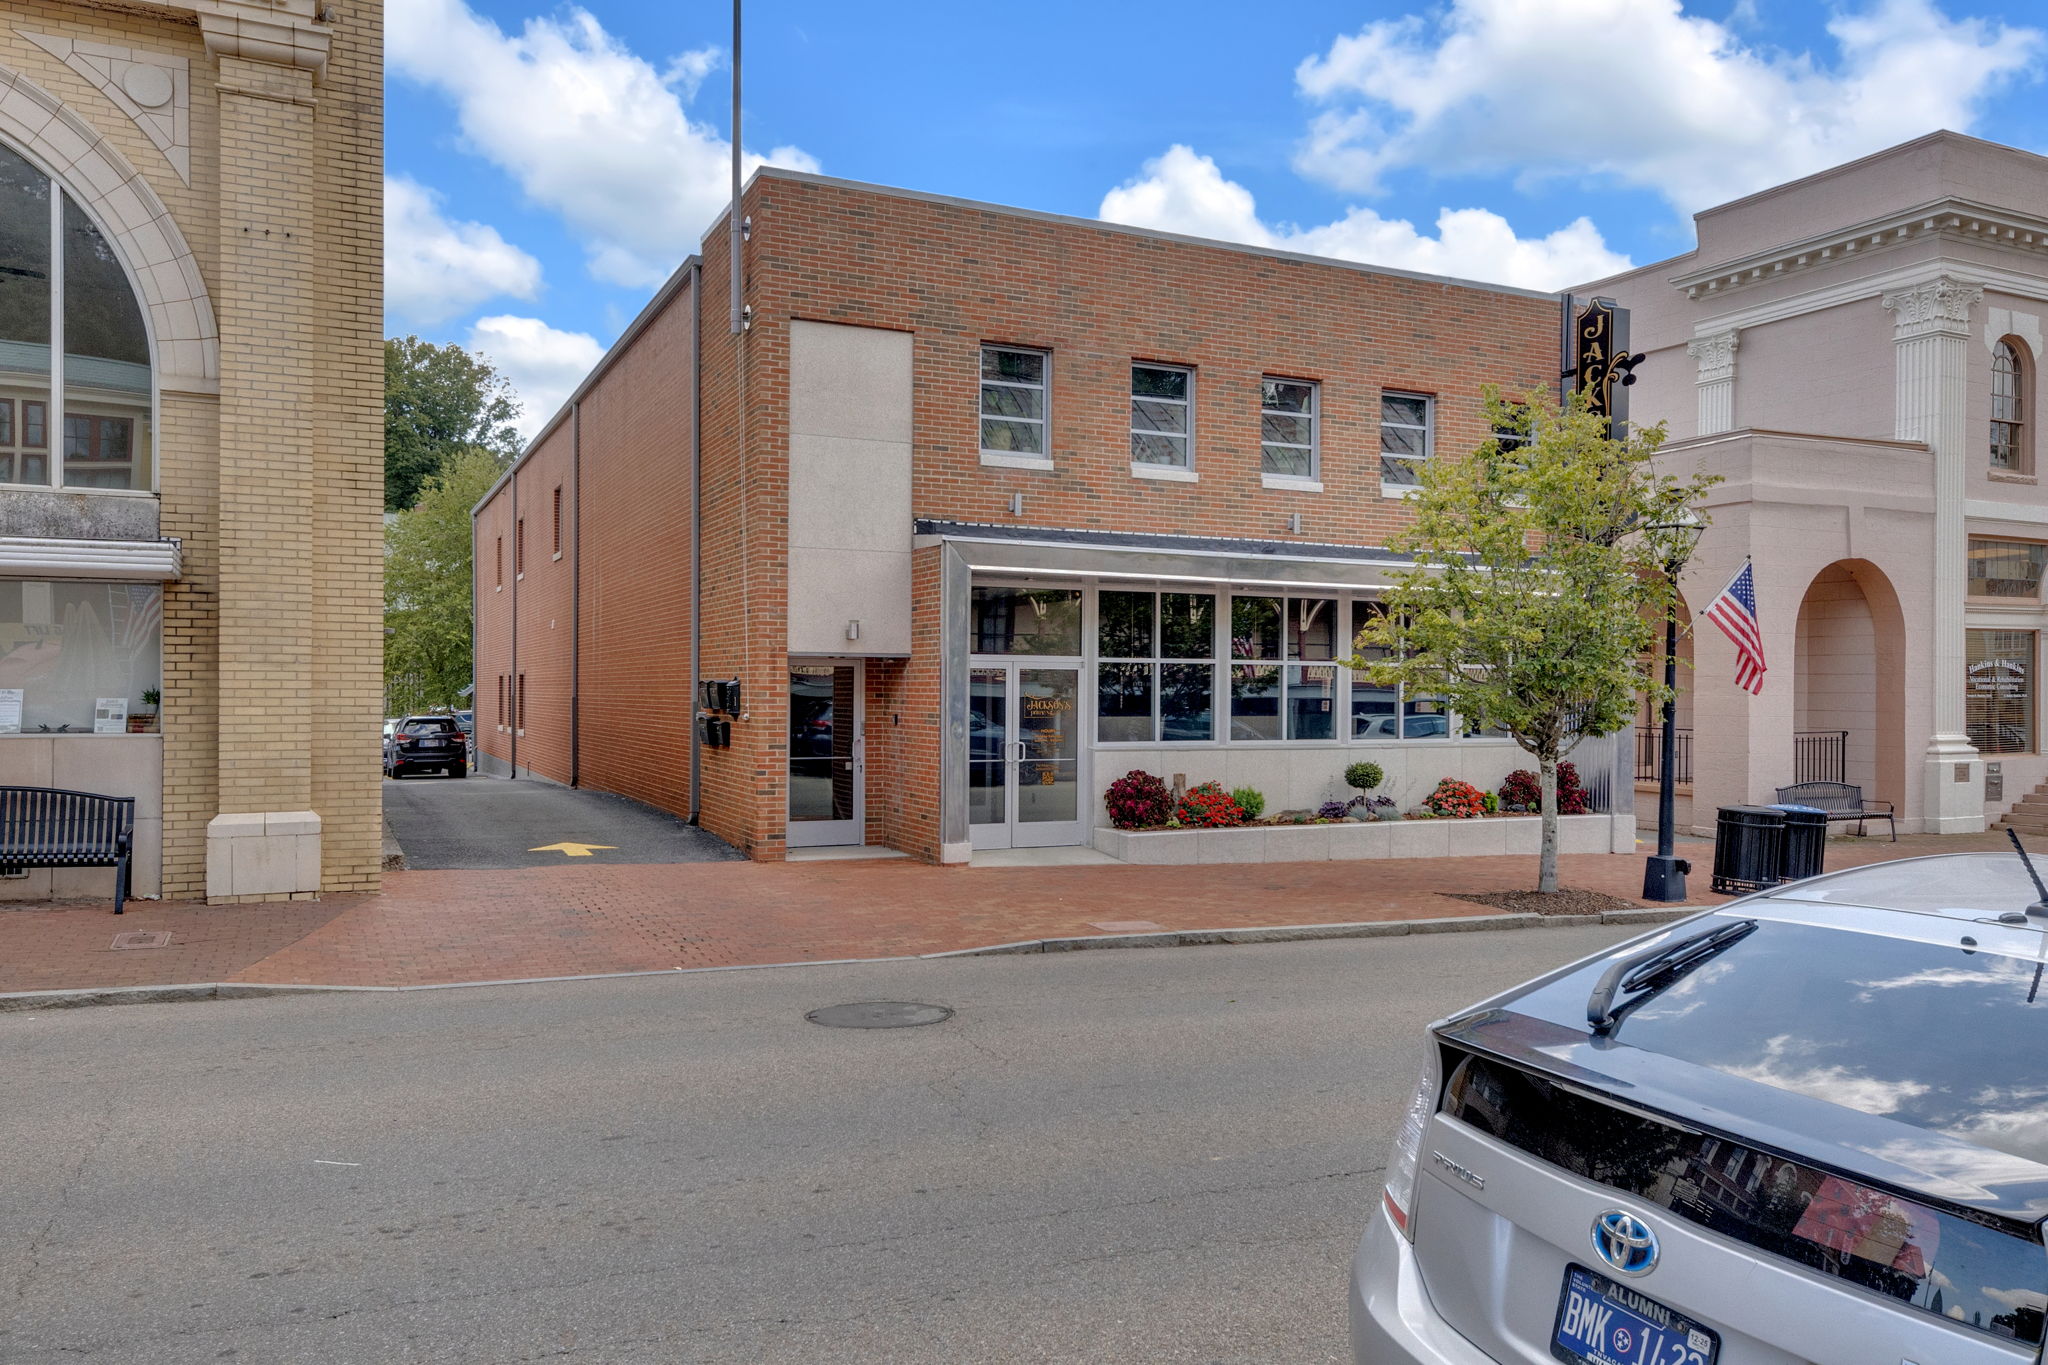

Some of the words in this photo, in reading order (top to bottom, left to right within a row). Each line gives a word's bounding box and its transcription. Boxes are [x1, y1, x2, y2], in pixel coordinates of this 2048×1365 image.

[1969, 660, 1993, 674] Hankins
[1994, 659, 2000, 667] &
[2001, 659, 2024, 675] Hankins
[1975, 682, 1996, 690] Economic
[1996, 682, 2019, 692] Consulting
[1026, 700, 1072, 710] JACKSON'S
[1432, 1150, 1485, 1190] PRIUS
[1607, 1282, 1672, 1328] ALUMNI
[1562, 1290, 1614, 1354] BMK
[1690, 1333, 1708, 1347] 12-25
